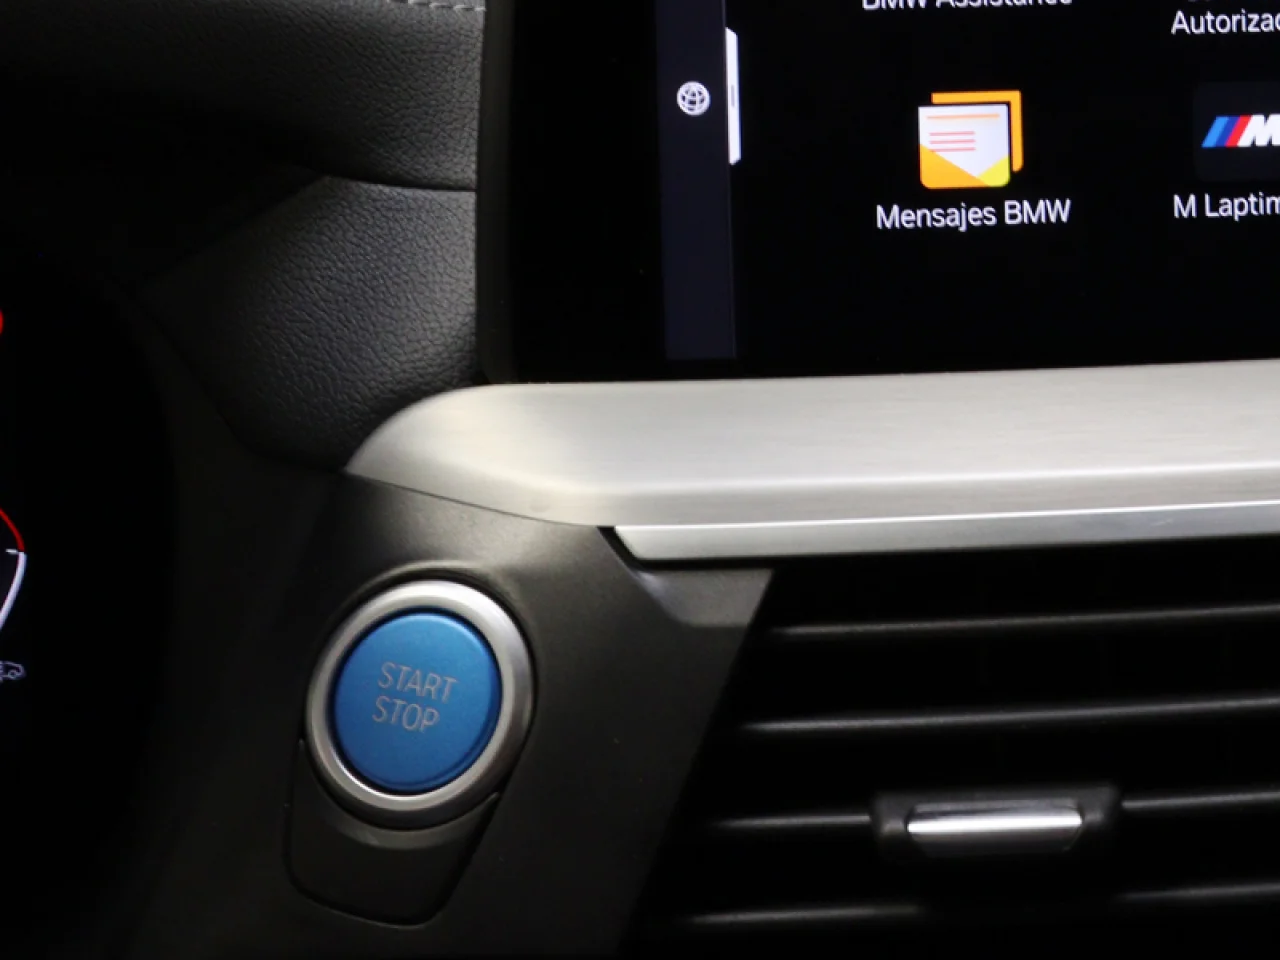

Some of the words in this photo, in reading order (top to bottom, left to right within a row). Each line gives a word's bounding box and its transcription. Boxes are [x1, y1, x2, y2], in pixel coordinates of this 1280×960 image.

[876, 204, 997, 233] Mensajes
[1004, 198, 1072, 225] BMW
[1173, 194, 1198, 219] M
[377, 661, 459, 704] START
[371, 695, 441, 733] STOP
